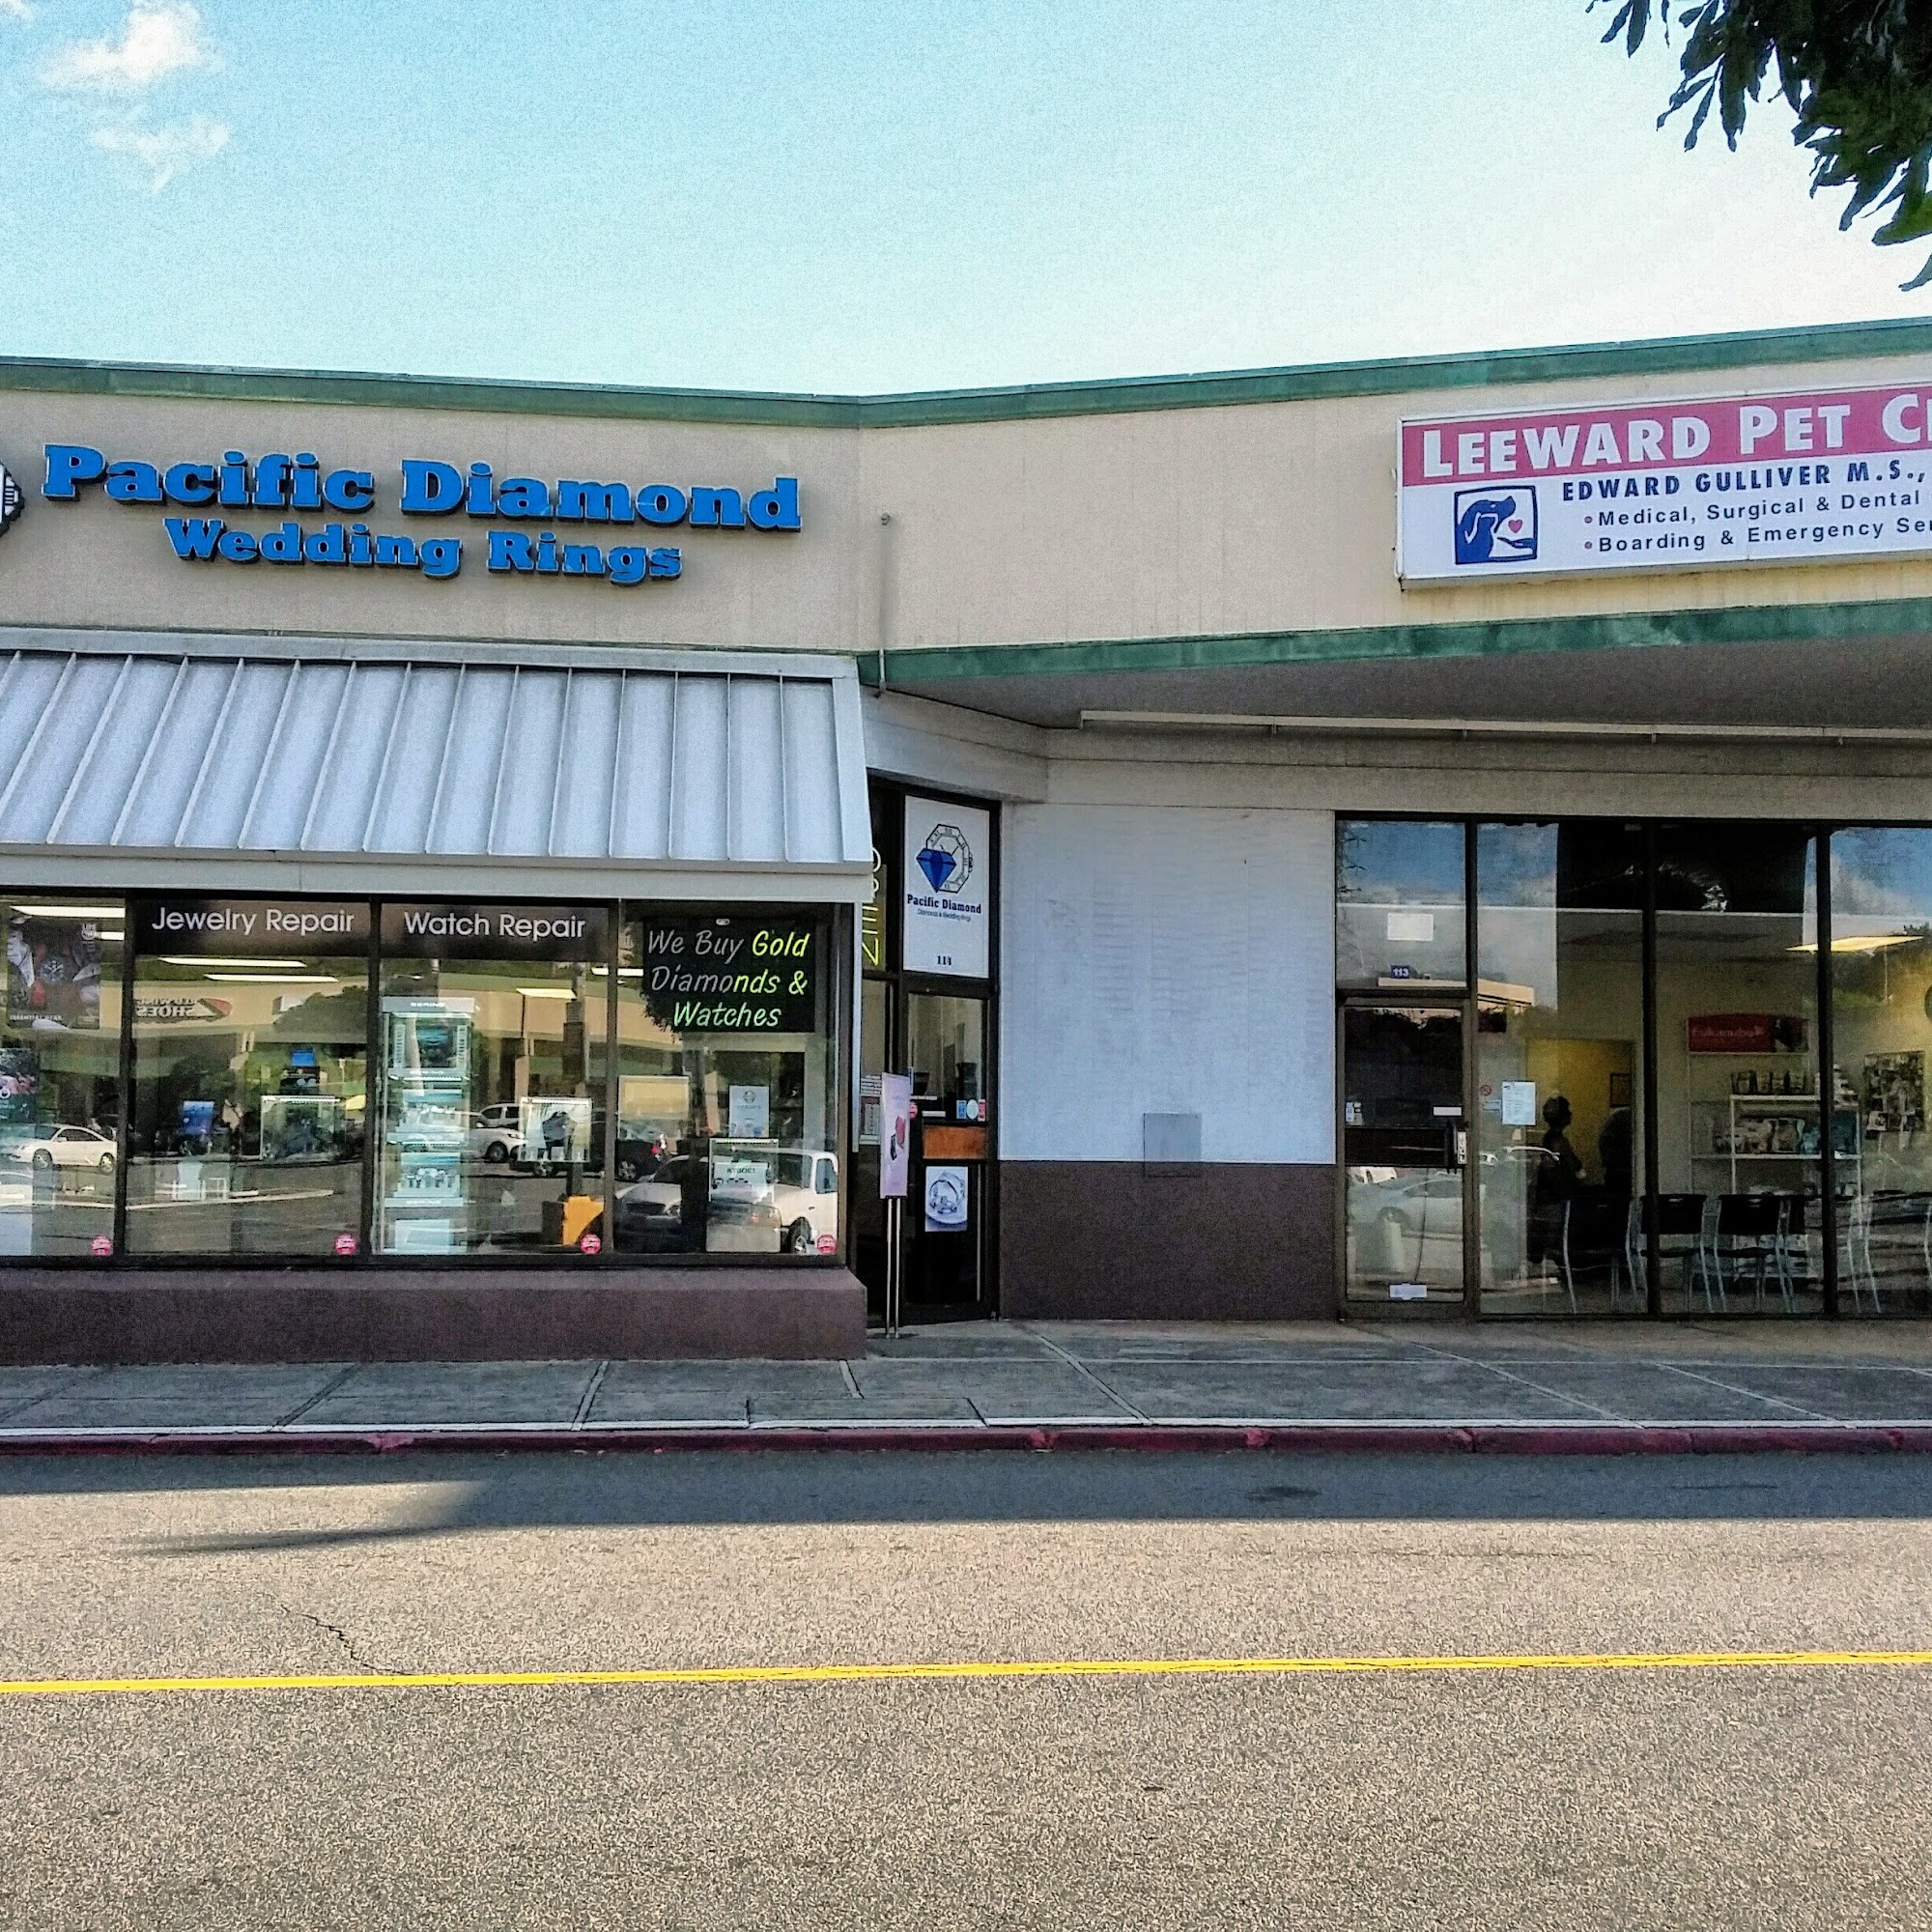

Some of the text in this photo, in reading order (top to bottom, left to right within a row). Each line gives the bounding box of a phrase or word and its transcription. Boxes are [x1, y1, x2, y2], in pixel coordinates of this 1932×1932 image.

[1423, 393, 1932, 478] LEEWARD PET C
[43, 443, 803, 532] Pacific Diamond
[1562, 460, 1925, 501] EDWARD GULLIVER M.S.,
[1599, 490, 1919, 526] Medical, Surgical & Dental
[163, 518, 683, 585] Wedding Rings
[1599, 530, 1706, 553] Boarding
[1720, 529, 1735, 546] &
[1747, 523, 1885, 543] Emergency
[907, 894, 981, 914] Pacific Diamond
[152, 907, 355, 936] Jewelry Repair
[404, 911, 585, 942] Watch Repair
[648, 929, 810, 964] We Buy Gold
[651, 964, 809, 995] Diamonds &
[1393, 968, 1409, 977] 113
[673, 1001, 782, 1028] Watches
